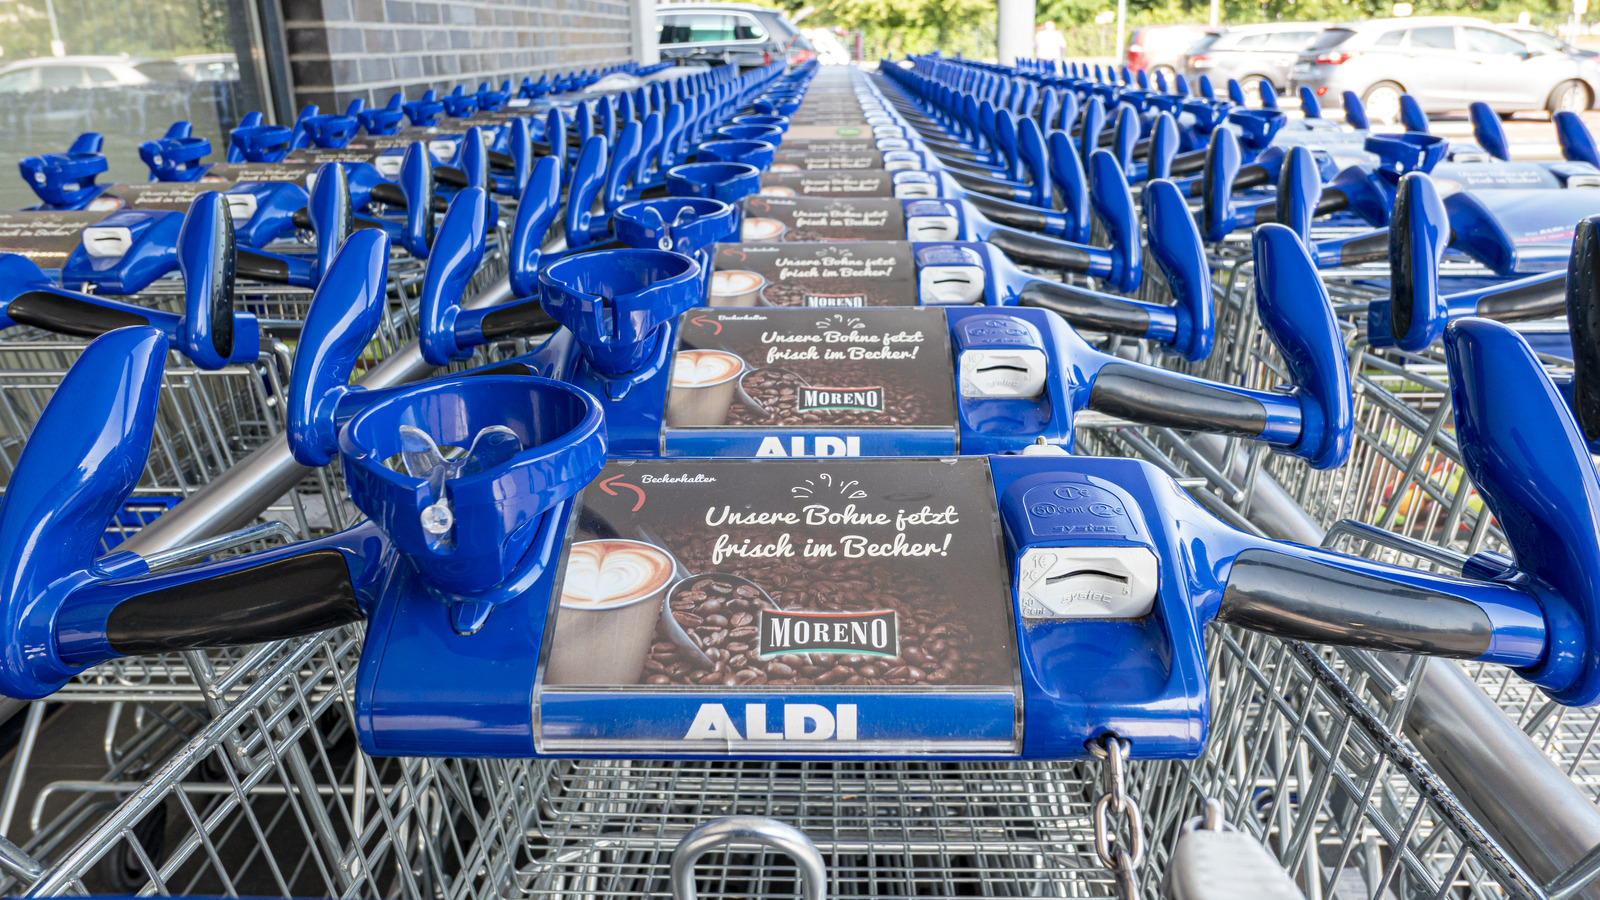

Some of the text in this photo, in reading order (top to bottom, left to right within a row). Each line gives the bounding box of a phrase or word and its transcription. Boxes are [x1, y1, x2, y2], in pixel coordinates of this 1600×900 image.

[808, 296, 863, 307] MORENO
[761, 330, 924, 346] Unsere Bohne jetzt
[766, 345, 920, 364] frisch im Becher!
[804, 390, 878, 408] MORENO
[755, 436, 860, 457] ALDI
[641, 474, 717, 485] Becherhalter
[705, 504, 960, 531] Unsere Bohne jetzt
[712, 533, 953, 565] frisch im Becher!
[1061, 589, 1114, 605] systec
[769, 617, 888, 649] MORENO
[684, 703, 858, 740] ALDI
